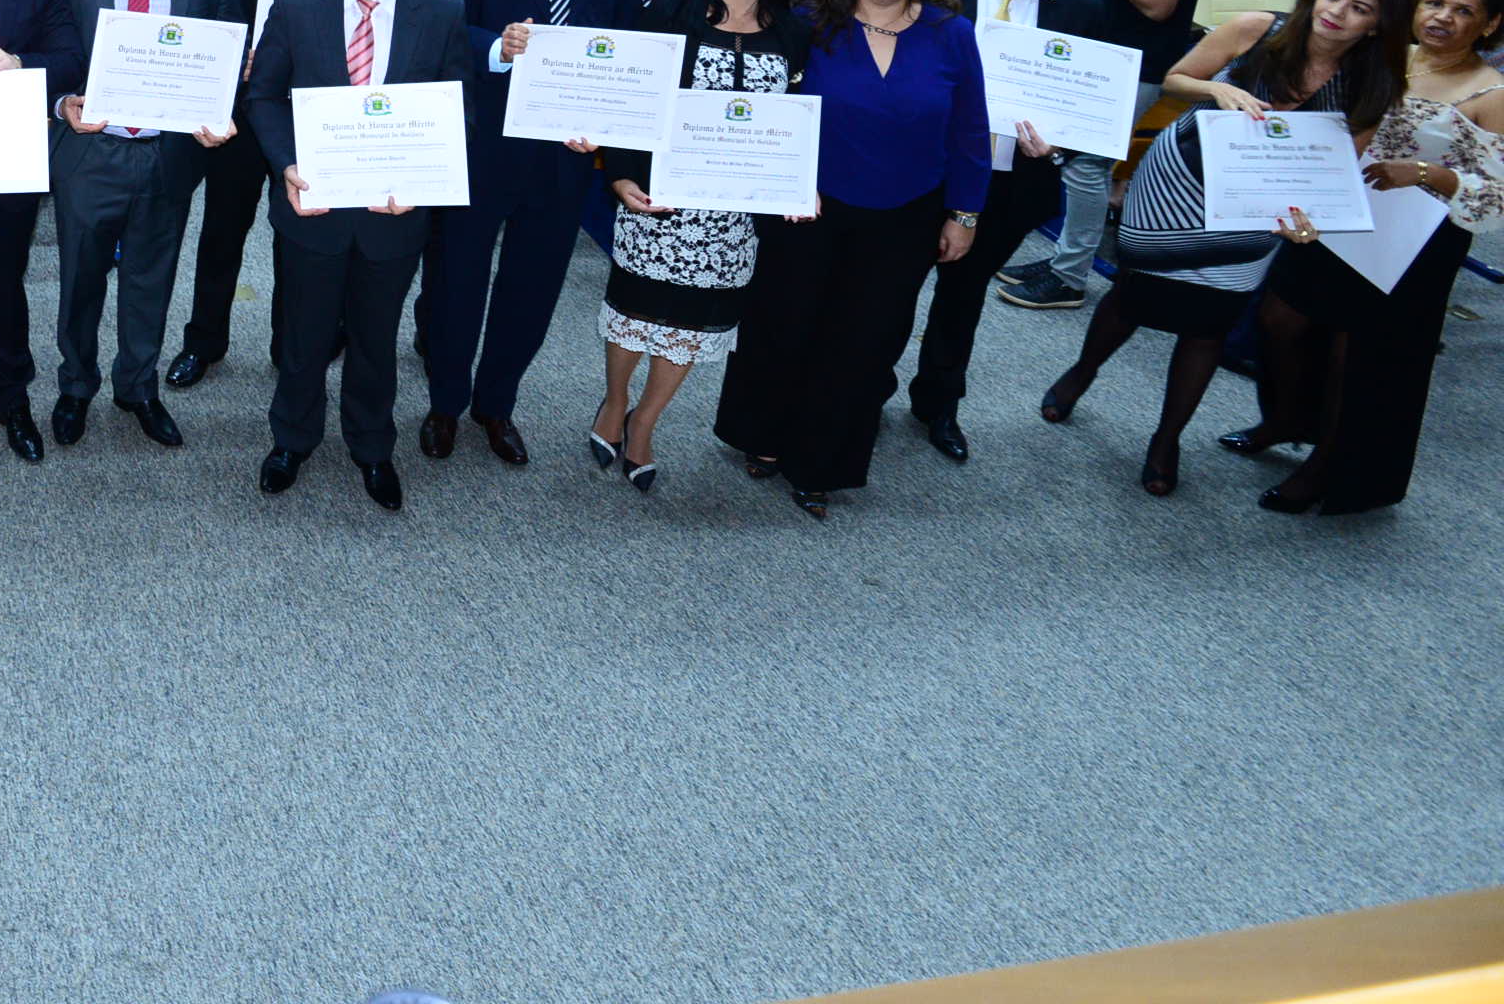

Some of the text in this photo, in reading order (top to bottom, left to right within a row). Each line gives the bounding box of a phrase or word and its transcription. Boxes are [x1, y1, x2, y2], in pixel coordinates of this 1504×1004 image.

[118, 44, 147, 56] Diploma
[148, 48, 156, 56] de
[159, 49, 180, 59] Honra
[193, 52, 217, 62] Mérito
[999, 52, 1031, 66] Diploma
[1033, 59, 1042, 68] de
[541, 57, 654, 76] Diploma de Honra ao Mérito
[322, 123, 355, 131] Diploma
[357, 122, 366, 130] de
[369, 120, 394, 129] Honra
[408, 120, 436, 129] Mérito
[682, 122, 793, 139] Diploma de Honra ao Mérito
